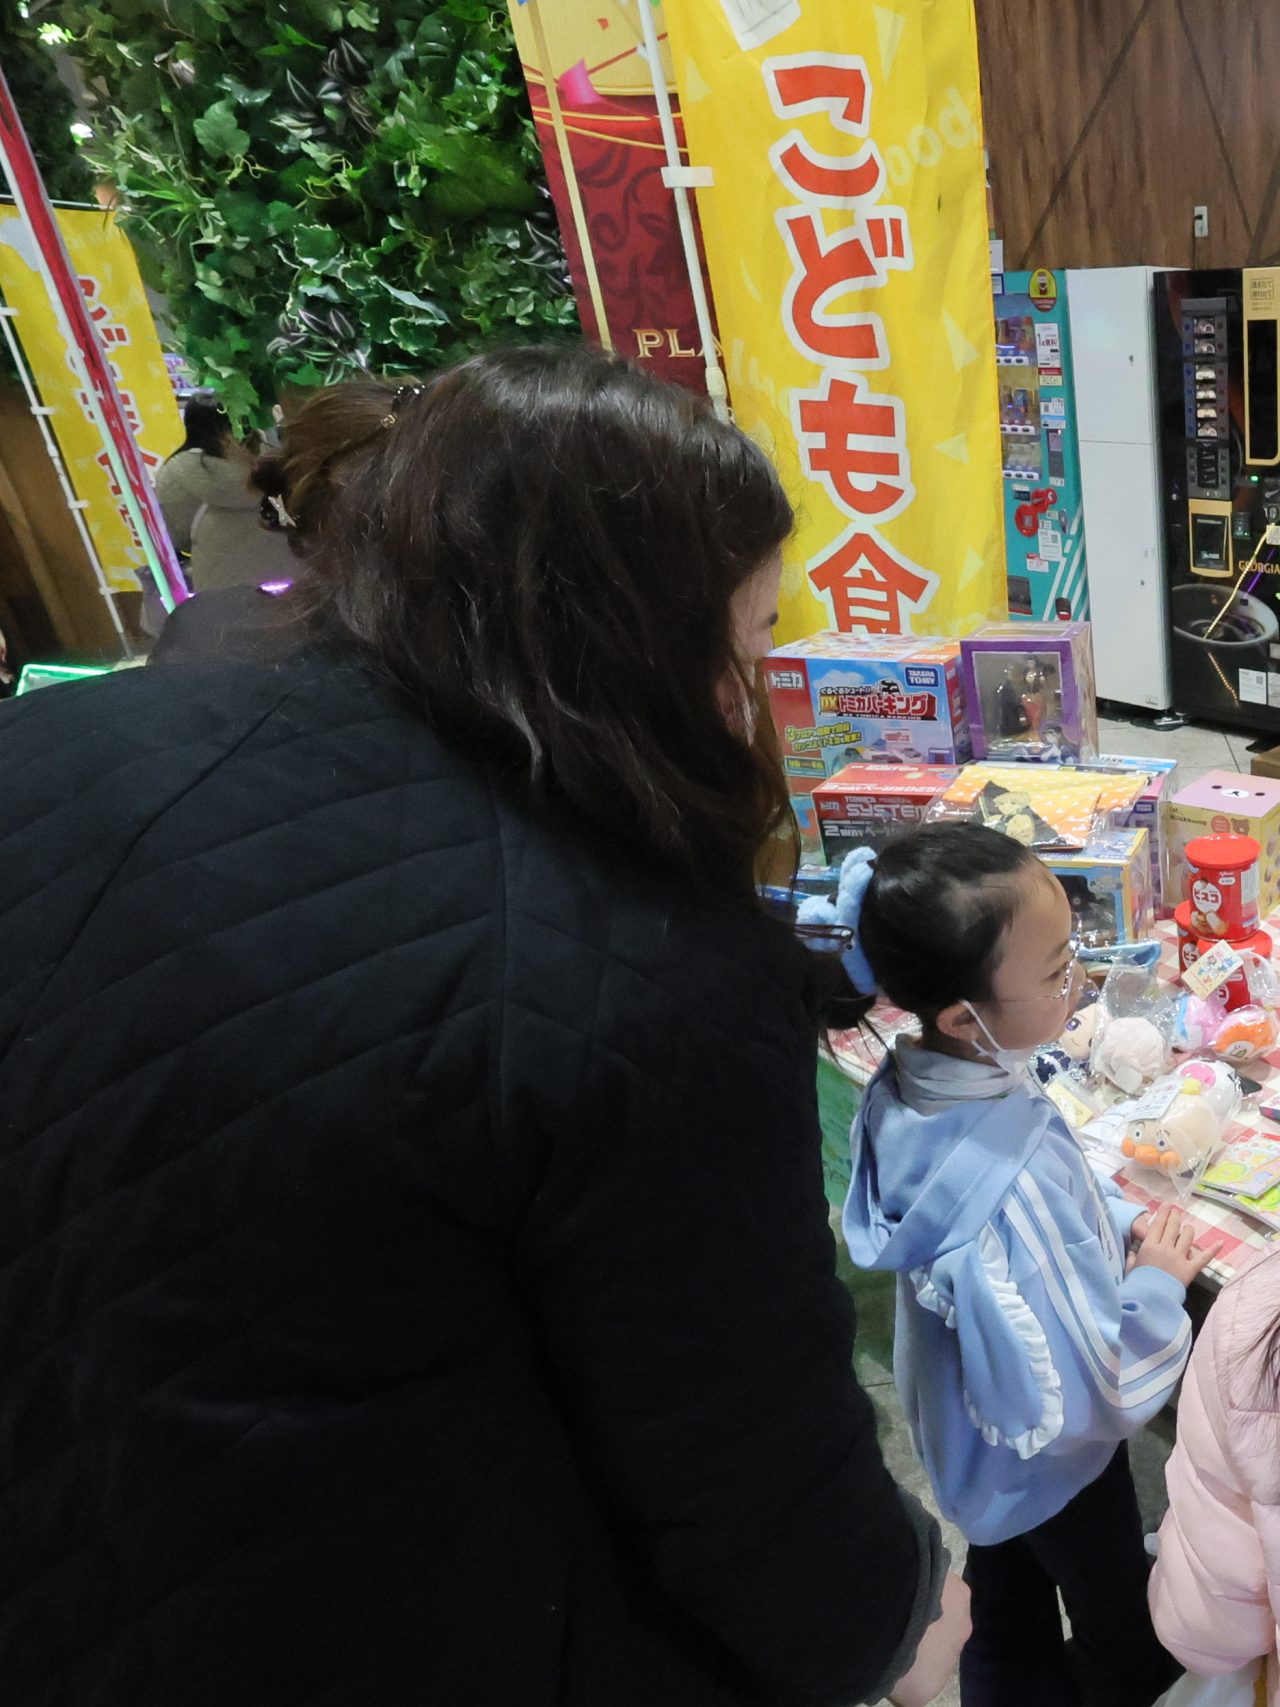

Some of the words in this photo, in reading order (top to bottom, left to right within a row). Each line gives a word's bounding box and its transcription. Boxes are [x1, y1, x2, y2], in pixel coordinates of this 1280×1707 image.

[769, 671, 803, 688] トミカ
[1194, 888, 1219, 904] ビスコ
